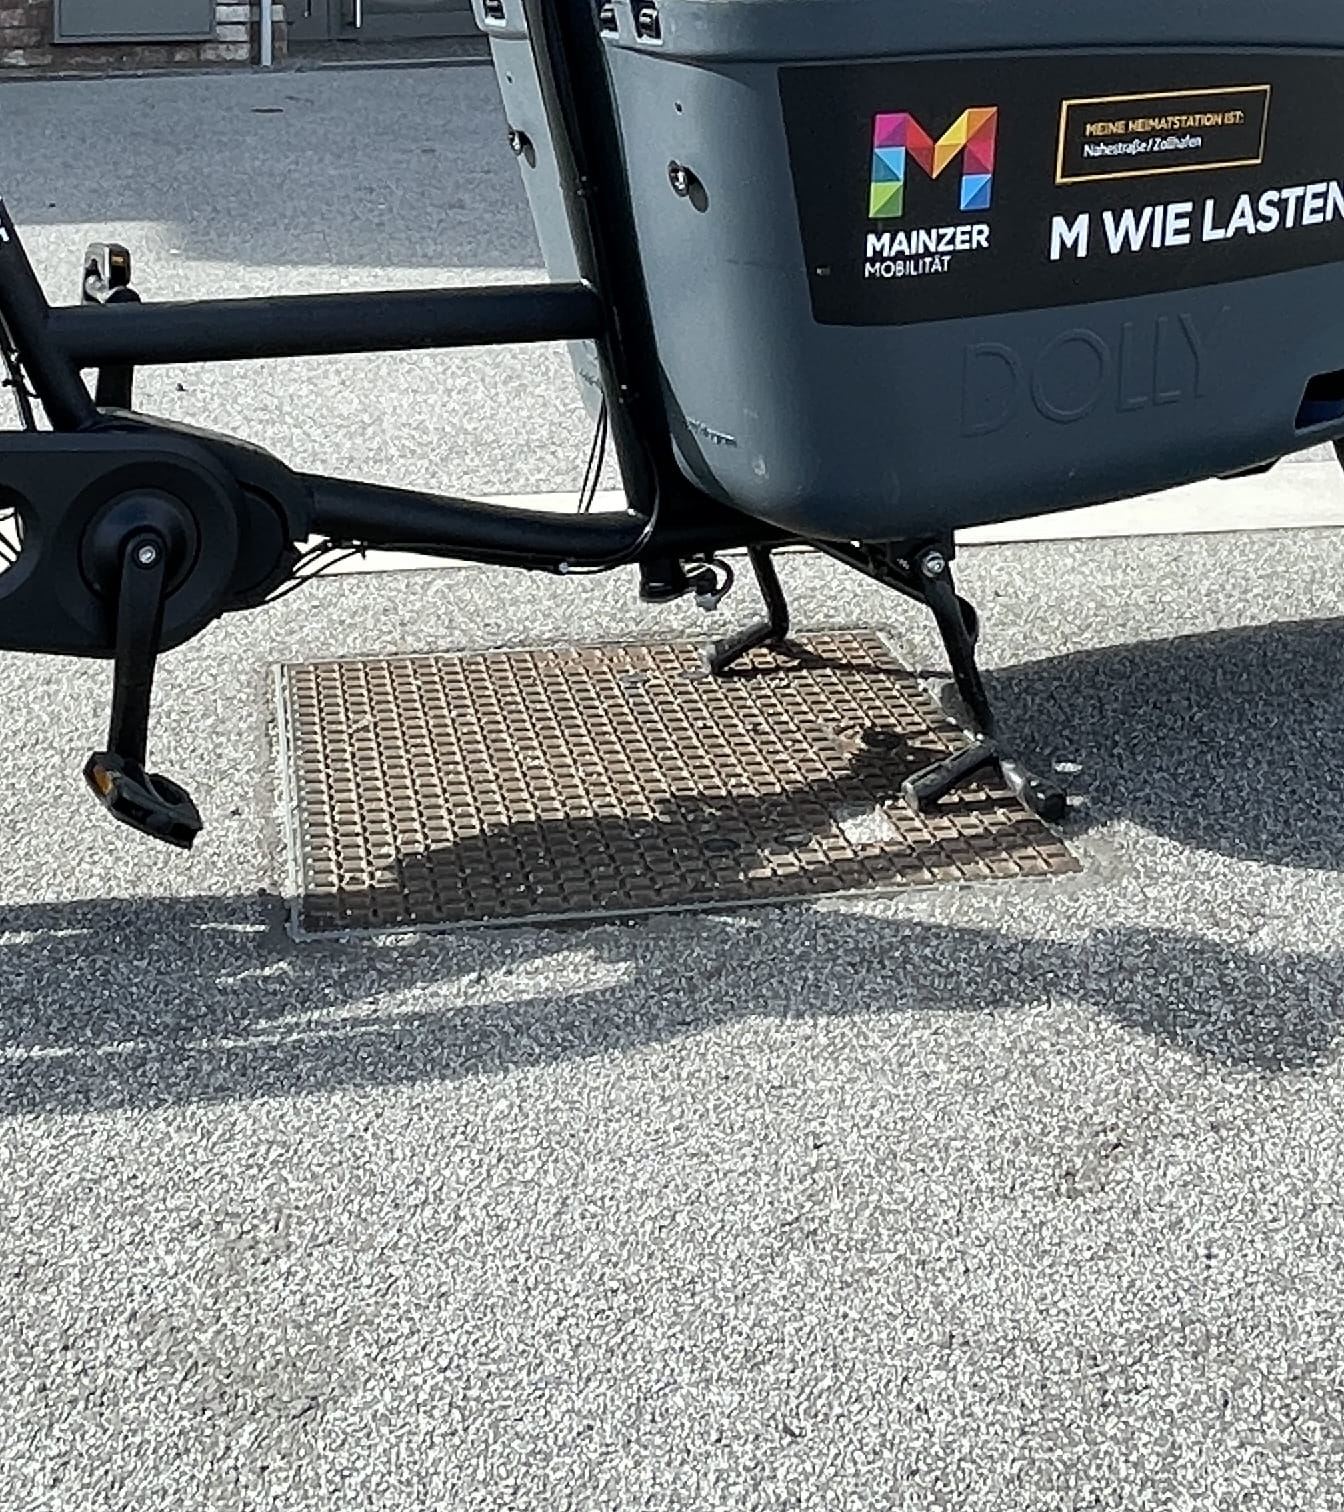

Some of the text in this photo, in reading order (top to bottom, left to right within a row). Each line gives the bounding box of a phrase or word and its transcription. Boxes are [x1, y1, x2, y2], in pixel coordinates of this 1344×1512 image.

[1085, 122, 1126, 136] MEINE
[866, 224, 990, 258] MAINZER
[1050, 213, 1089, 260] M
[1102, 201, 1193, 254] WIE
[864, 254, 952, 278] MOBILITÄT
[961, 306, 1231, 438] DOLLY
